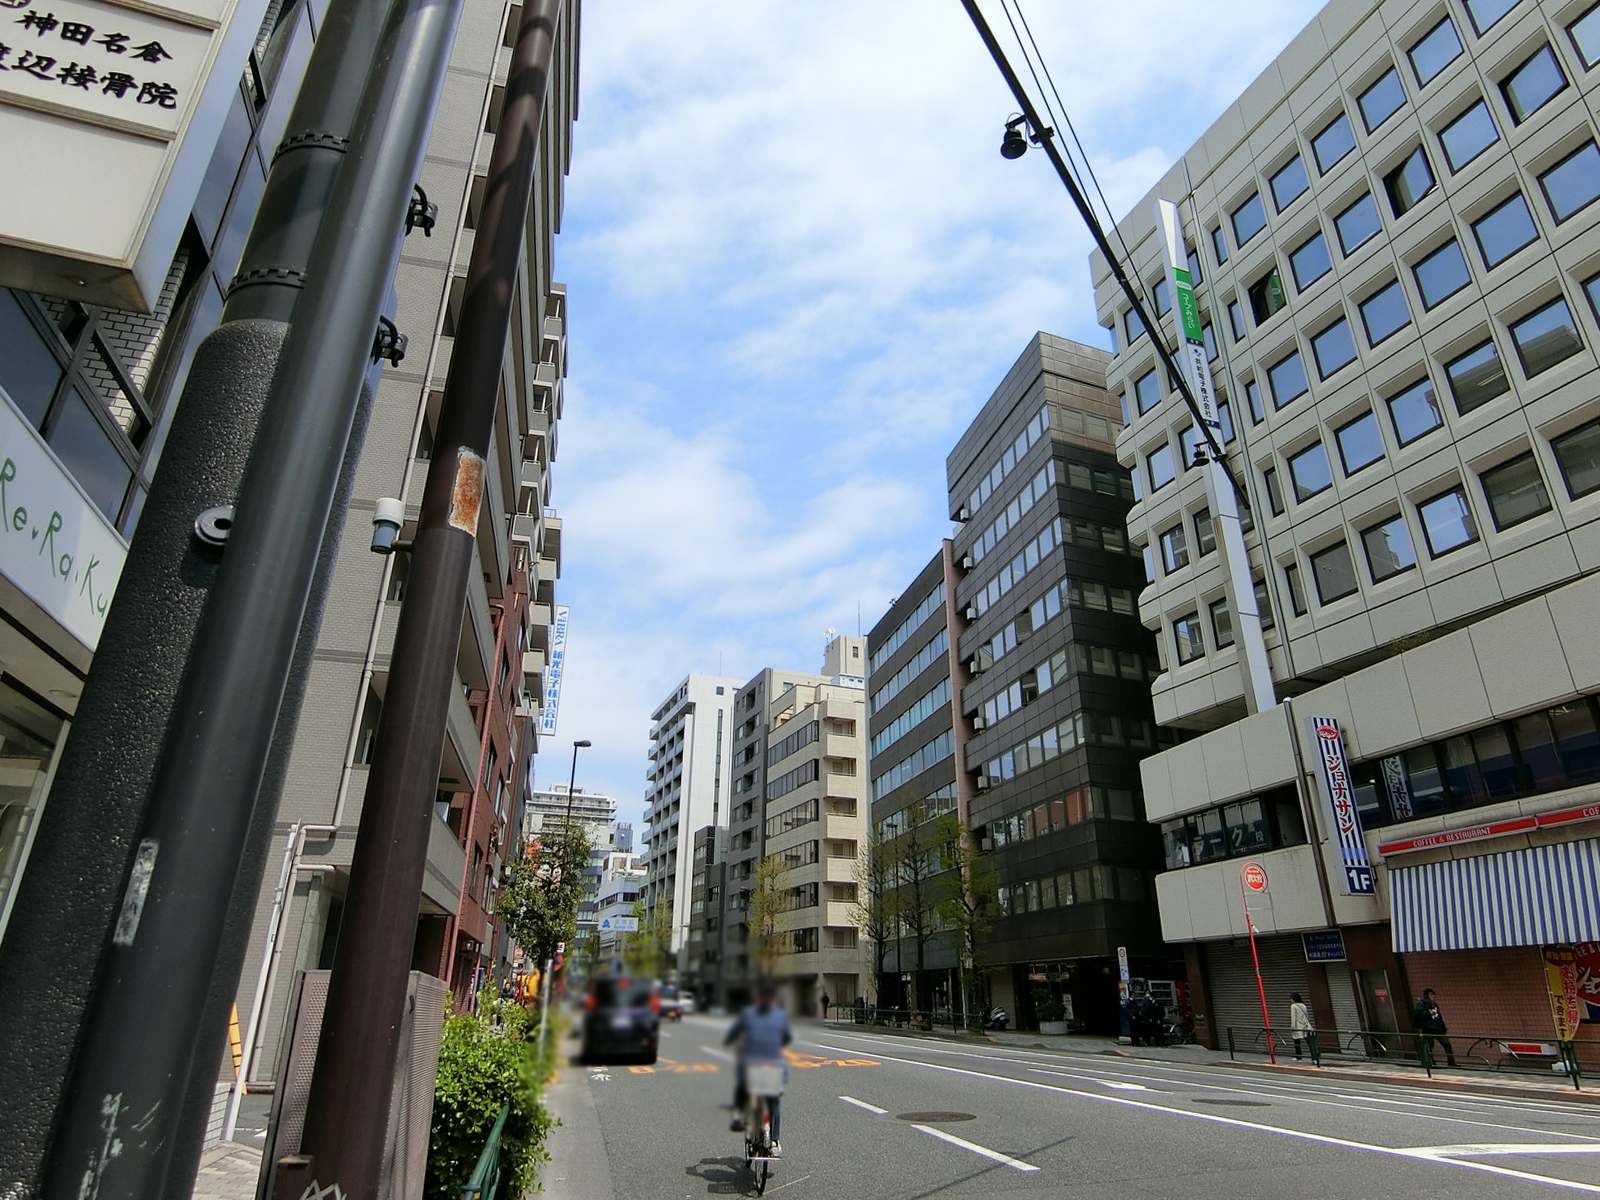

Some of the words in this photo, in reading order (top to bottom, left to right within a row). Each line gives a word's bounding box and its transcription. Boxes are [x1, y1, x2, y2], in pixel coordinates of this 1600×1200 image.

[14, 10, 173, 63] 神田名倉
[544, 650, 563, 729] 新光電子株式会社
[1326, 754, 1354, 834] ジョナサン
[1412, 837, 1436, 848] COFFEE
[1446, 828, 1491, 842] RESTAURANT
[1348, 869, 1371, 891] 1F
[1553, 994, 1568, 1038] できます
